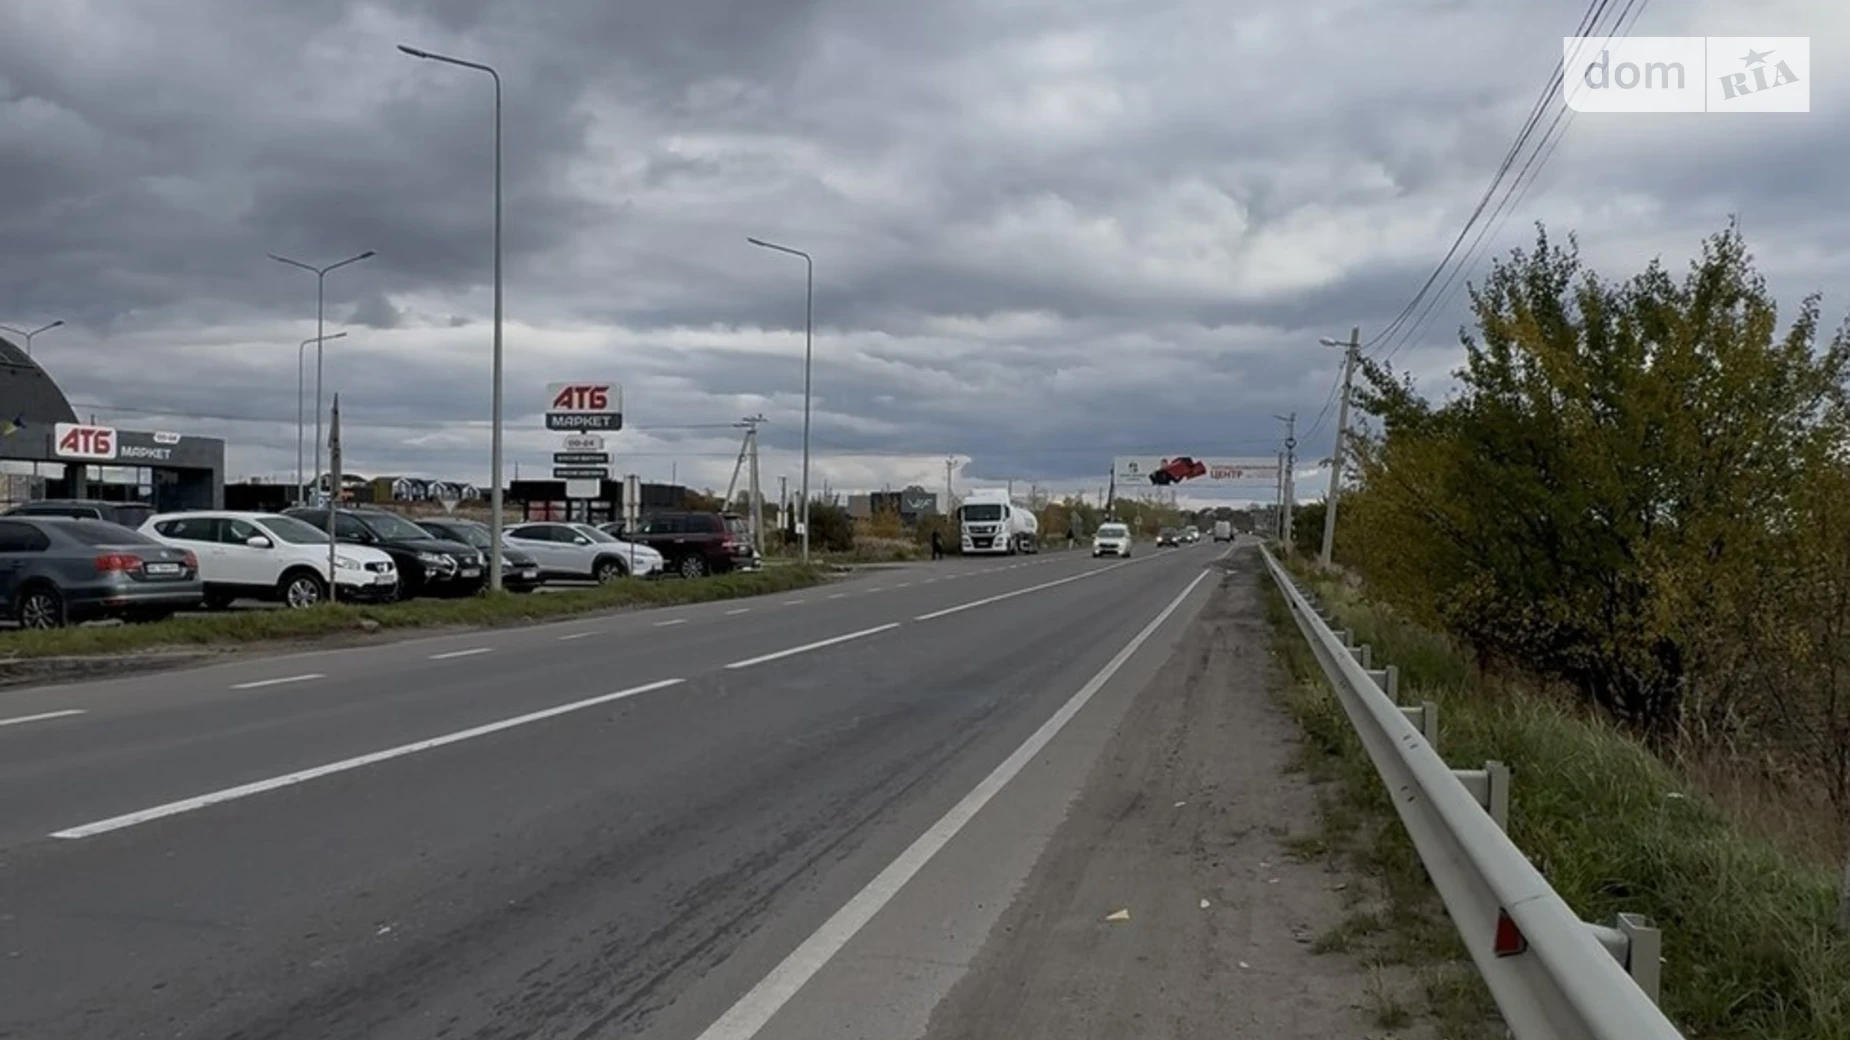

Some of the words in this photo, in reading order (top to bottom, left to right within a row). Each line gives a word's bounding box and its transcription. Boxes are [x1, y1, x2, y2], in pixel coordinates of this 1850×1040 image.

[552, 385, 609, 409] АТБ
[551, 415, 612, 427] МАРКЕТ
[58, 427, 113, 455] АТБ
[120, 445, 172, 460] МАРКЕТ
[1210, 470, 1243, 481] ЦЕНТР
